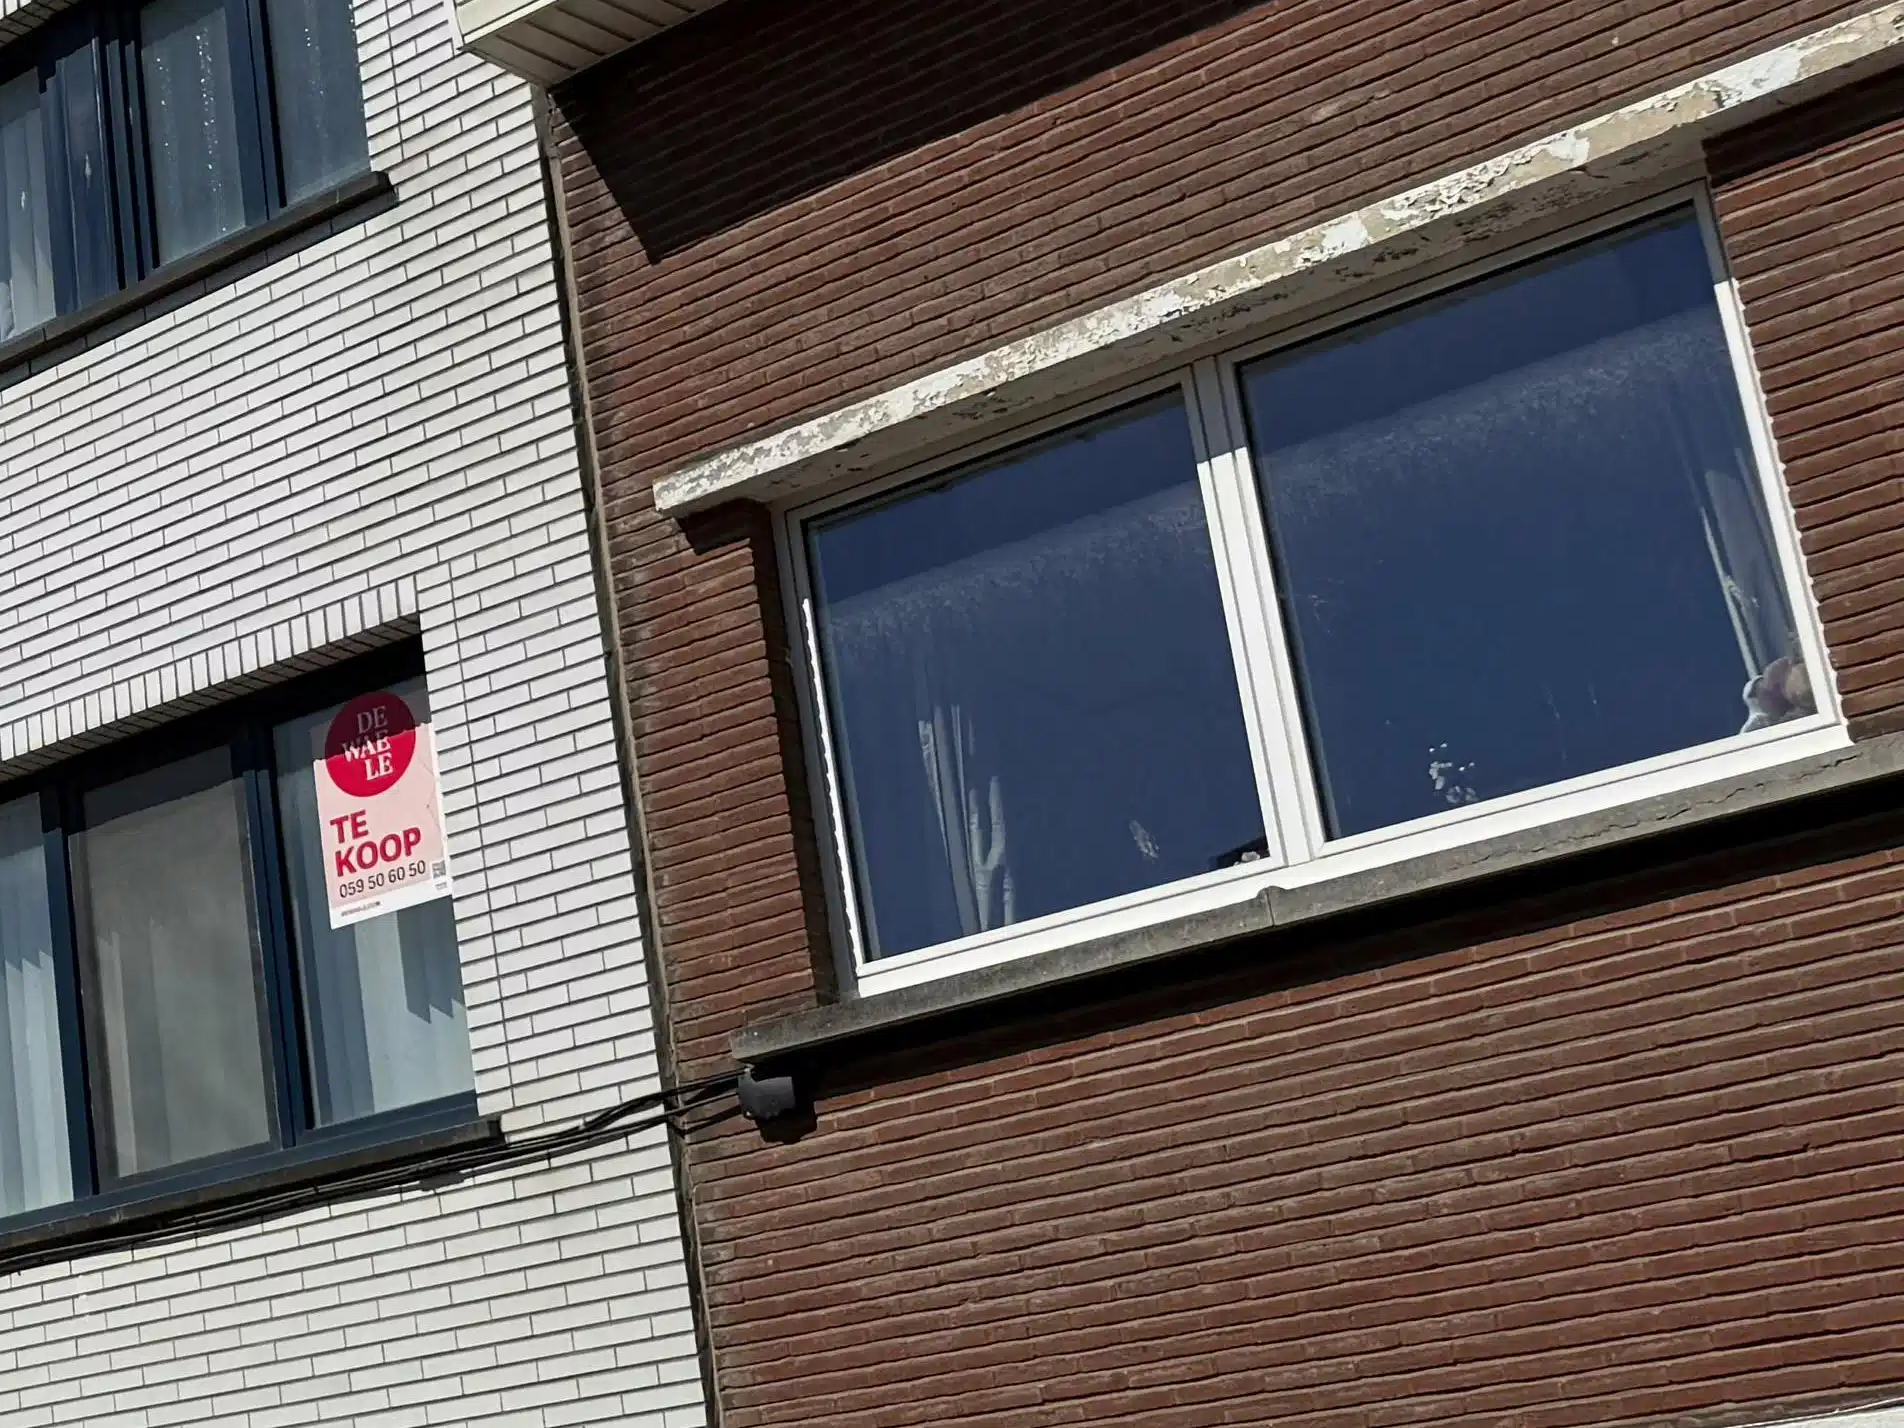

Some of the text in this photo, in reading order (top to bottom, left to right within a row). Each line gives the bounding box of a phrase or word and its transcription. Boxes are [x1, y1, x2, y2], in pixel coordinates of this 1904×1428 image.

[357, 705, 388, 734] DE
[341, 728, 392, 763] WAE
[364, 752, 394, 781] LE
[329, 809, 369, 844] TE
[334, 827, 422, 877] KOOP
[339, 859, 427, 898] 059 50 60 50
